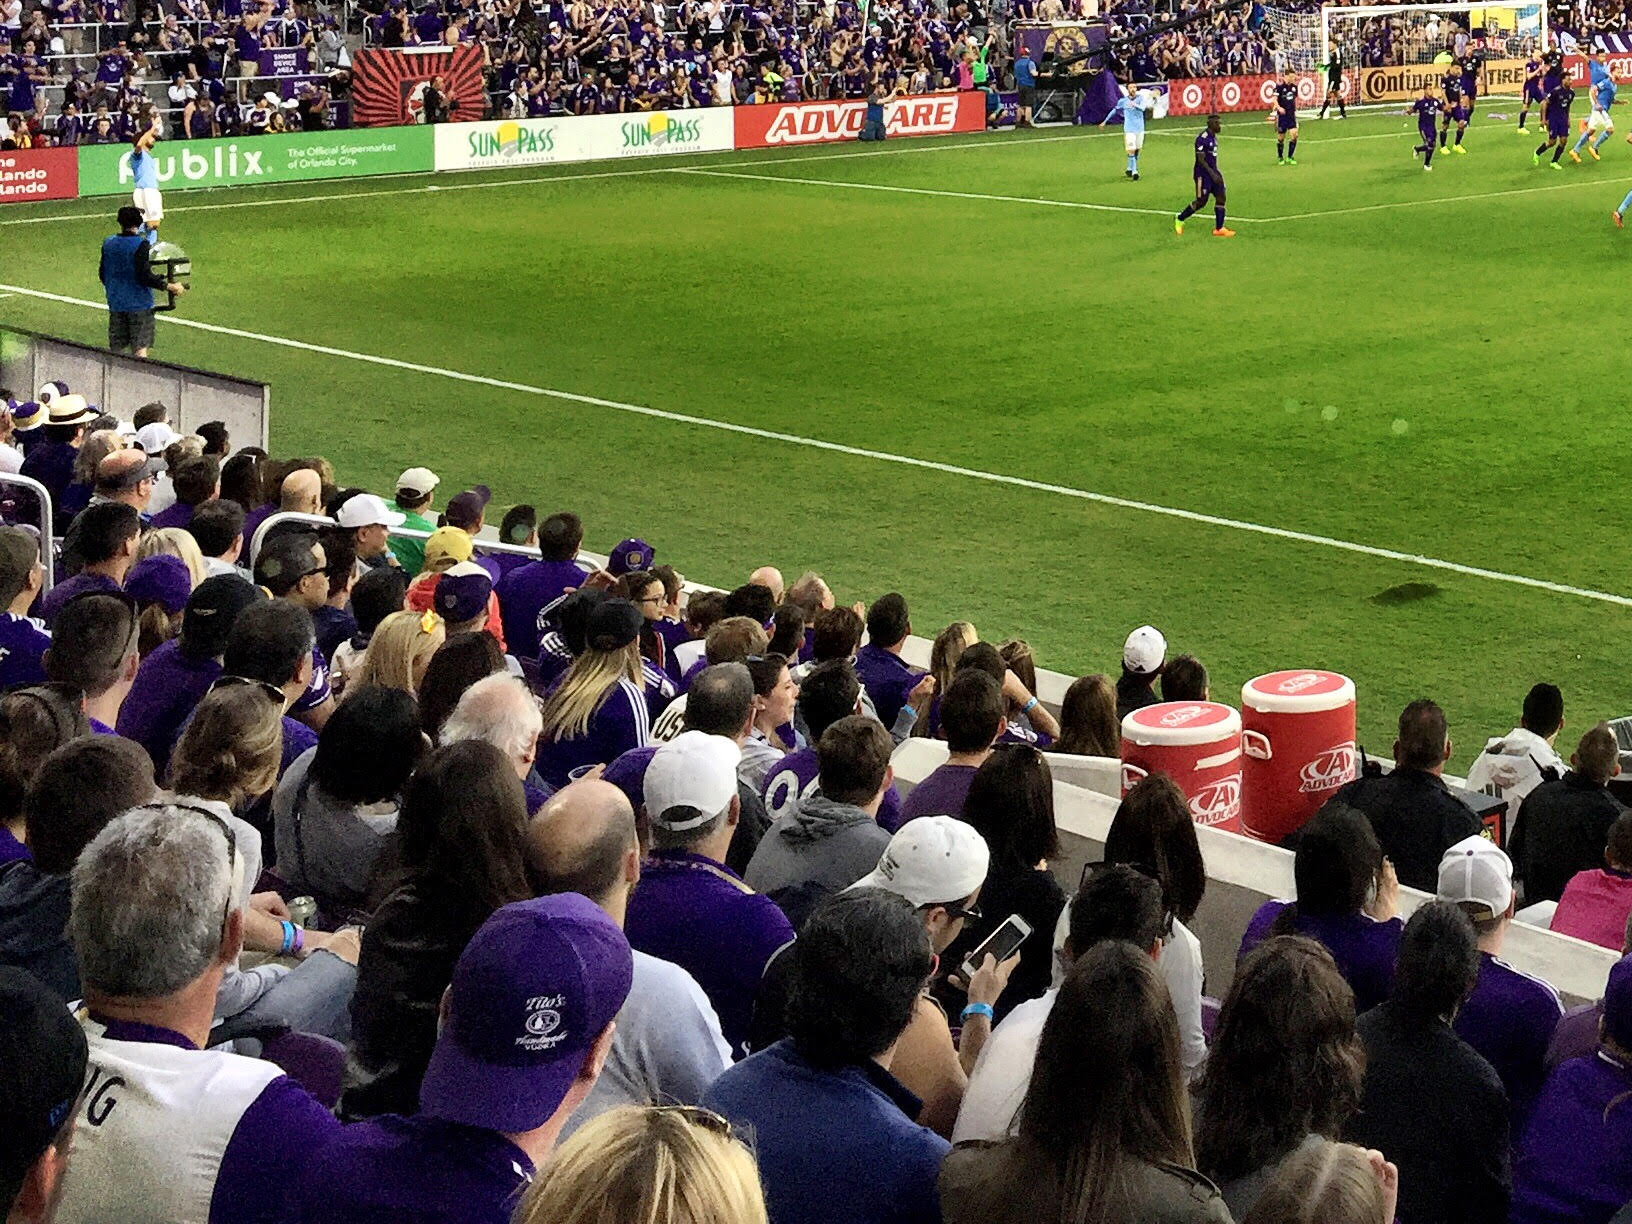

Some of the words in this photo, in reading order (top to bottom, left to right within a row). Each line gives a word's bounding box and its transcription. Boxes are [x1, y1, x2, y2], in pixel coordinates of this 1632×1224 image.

[1488, 67, 1524, 86] TIRE
[771, 100, 955, 138] ADVOARE
[287, 148, 305, 157] The
[306, 145, 339, 156] Official
[340, 143, 397, 155] Supermarket
[287, 160, 298, 169] of
[299, 156, 337, 168] Orlando
[525, 993, 567, 1012] Tito's
